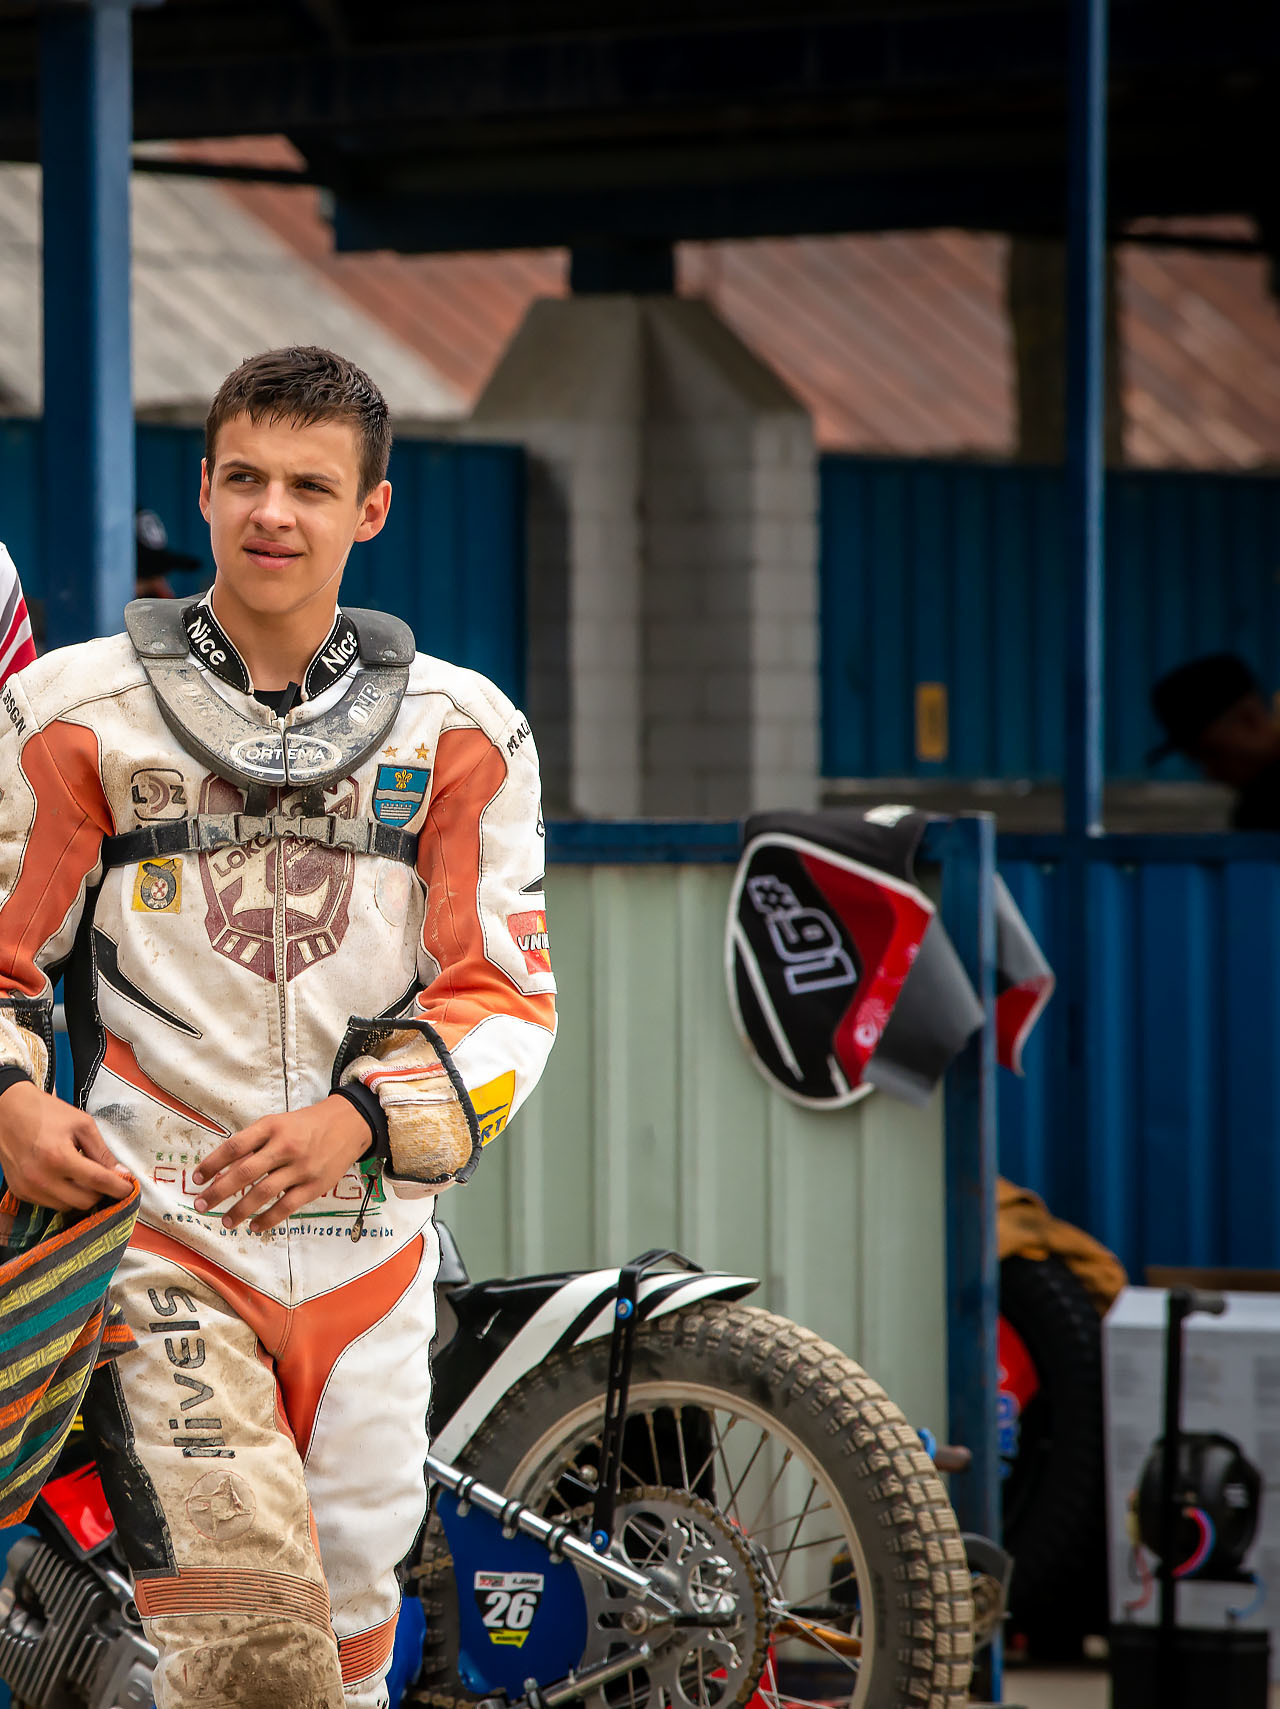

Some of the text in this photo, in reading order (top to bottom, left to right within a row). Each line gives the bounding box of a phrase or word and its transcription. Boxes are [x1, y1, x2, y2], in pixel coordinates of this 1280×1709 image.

[187, 616, 227, 666] Nice
[320, 630, 358, 674] Nice
[245, 747, 326, 761] ORTEMA
[482, 1591, 538, 1630] 26
